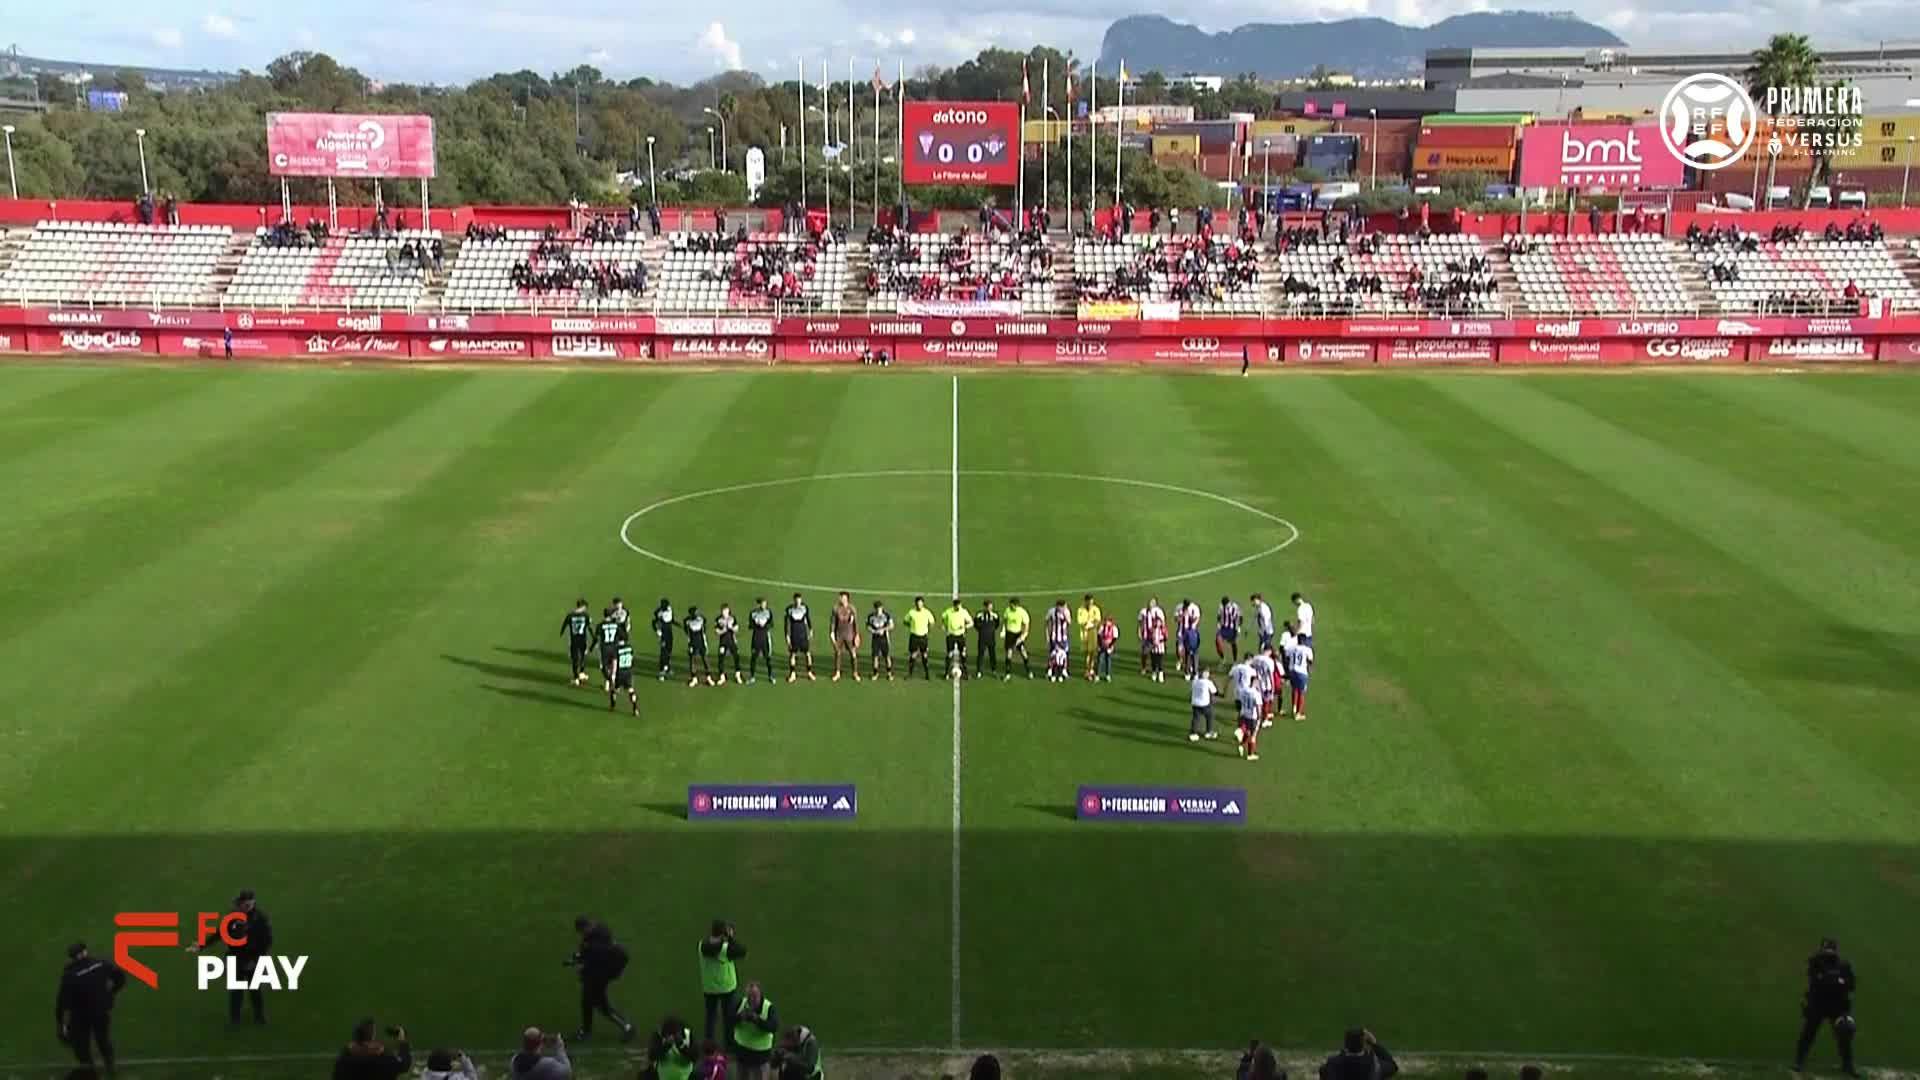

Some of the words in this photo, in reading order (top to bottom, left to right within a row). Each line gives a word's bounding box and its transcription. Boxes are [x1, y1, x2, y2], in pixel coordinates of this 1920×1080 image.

[933, 107, 988, 124] datono
[1562, 130, 1642, 162] bmt
[938, 143, 954, 163] 0
[967, 143, 983, 163] 0
[932, 171, 942, 180] La
[1561, 174, 1641, 184] REPAIRS
[946, 341, 998, 352] HYUNDAI
[1055, 341, 1108, 354] SUITEX
[1179, 799, 1217, 808] VERSUS
